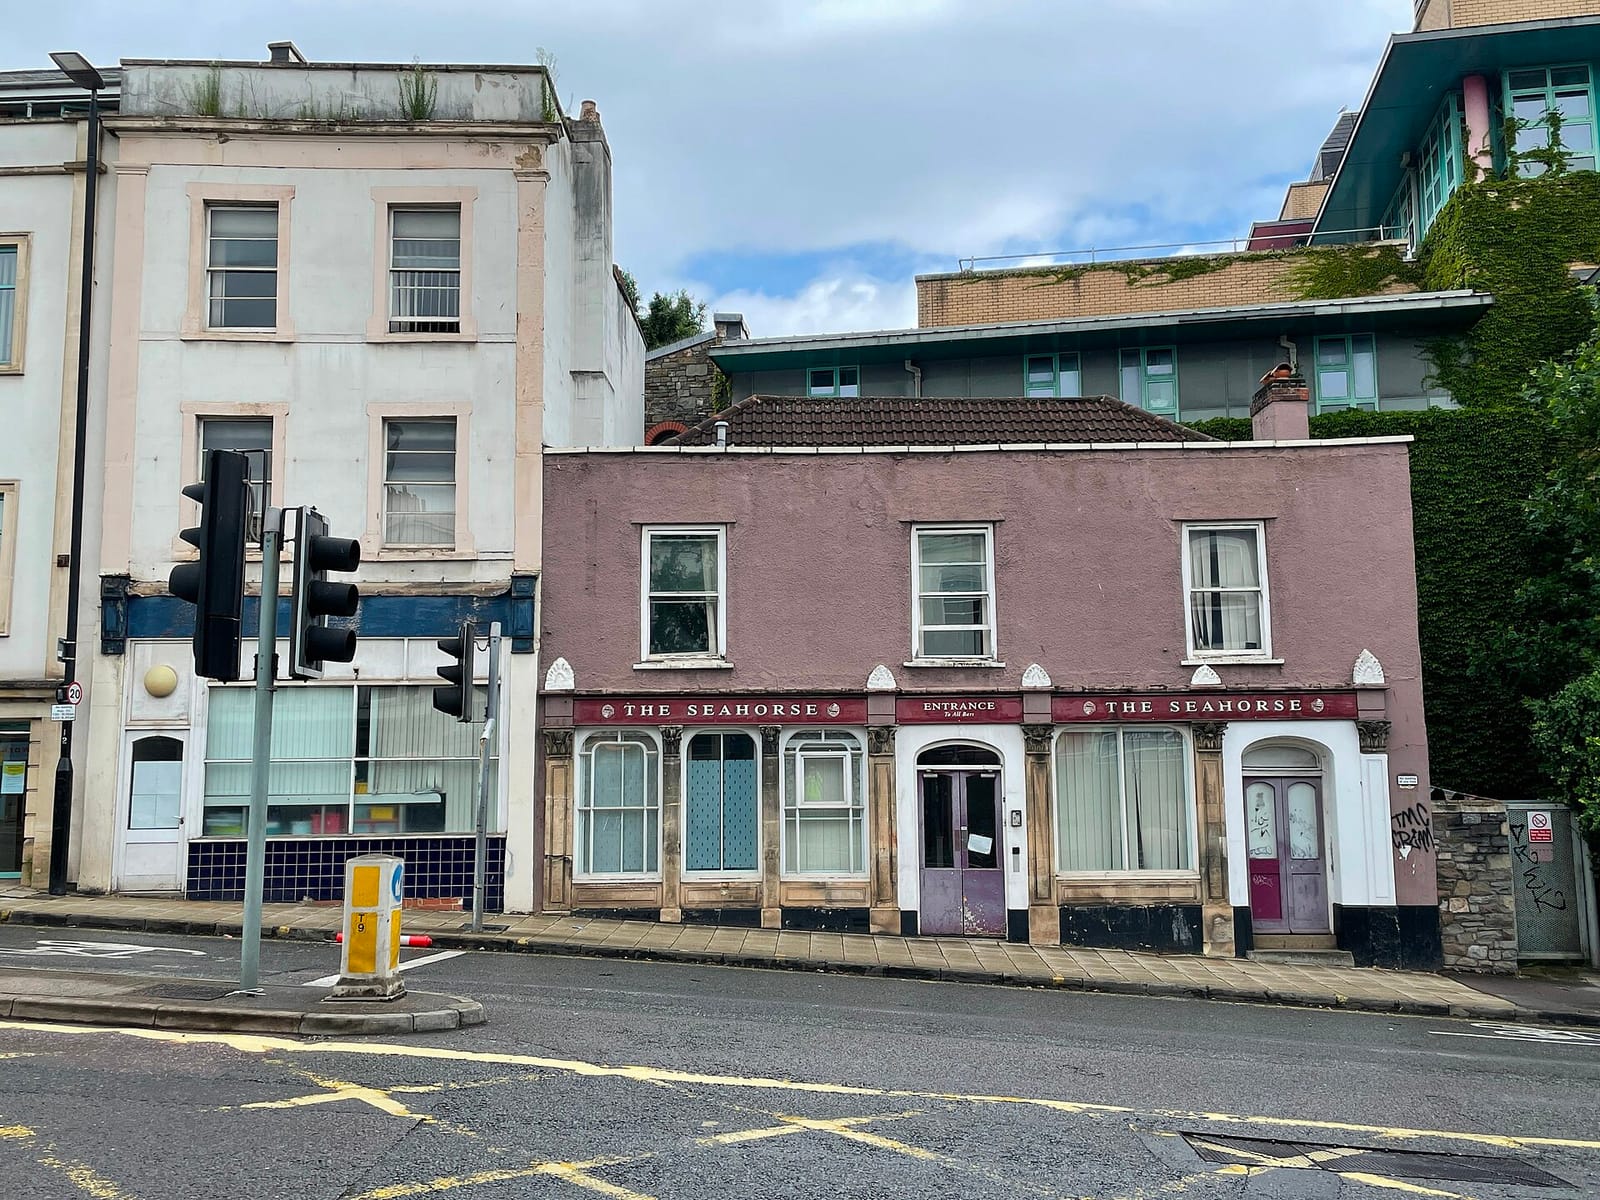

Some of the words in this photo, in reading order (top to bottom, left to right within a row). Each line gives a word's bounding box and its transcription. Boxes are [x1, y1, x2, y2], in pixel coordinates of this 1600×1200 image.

[70, 688, 81, 699] 20
[623, 703, 672, 717] THE
[687, 703, 819, 717] SEAHORSE
[924, 702, 995, 711] ENTRANCE
[1105, 701, 1153, 713] THE
[1170, 700, 1302, 712] SEAHORSE
